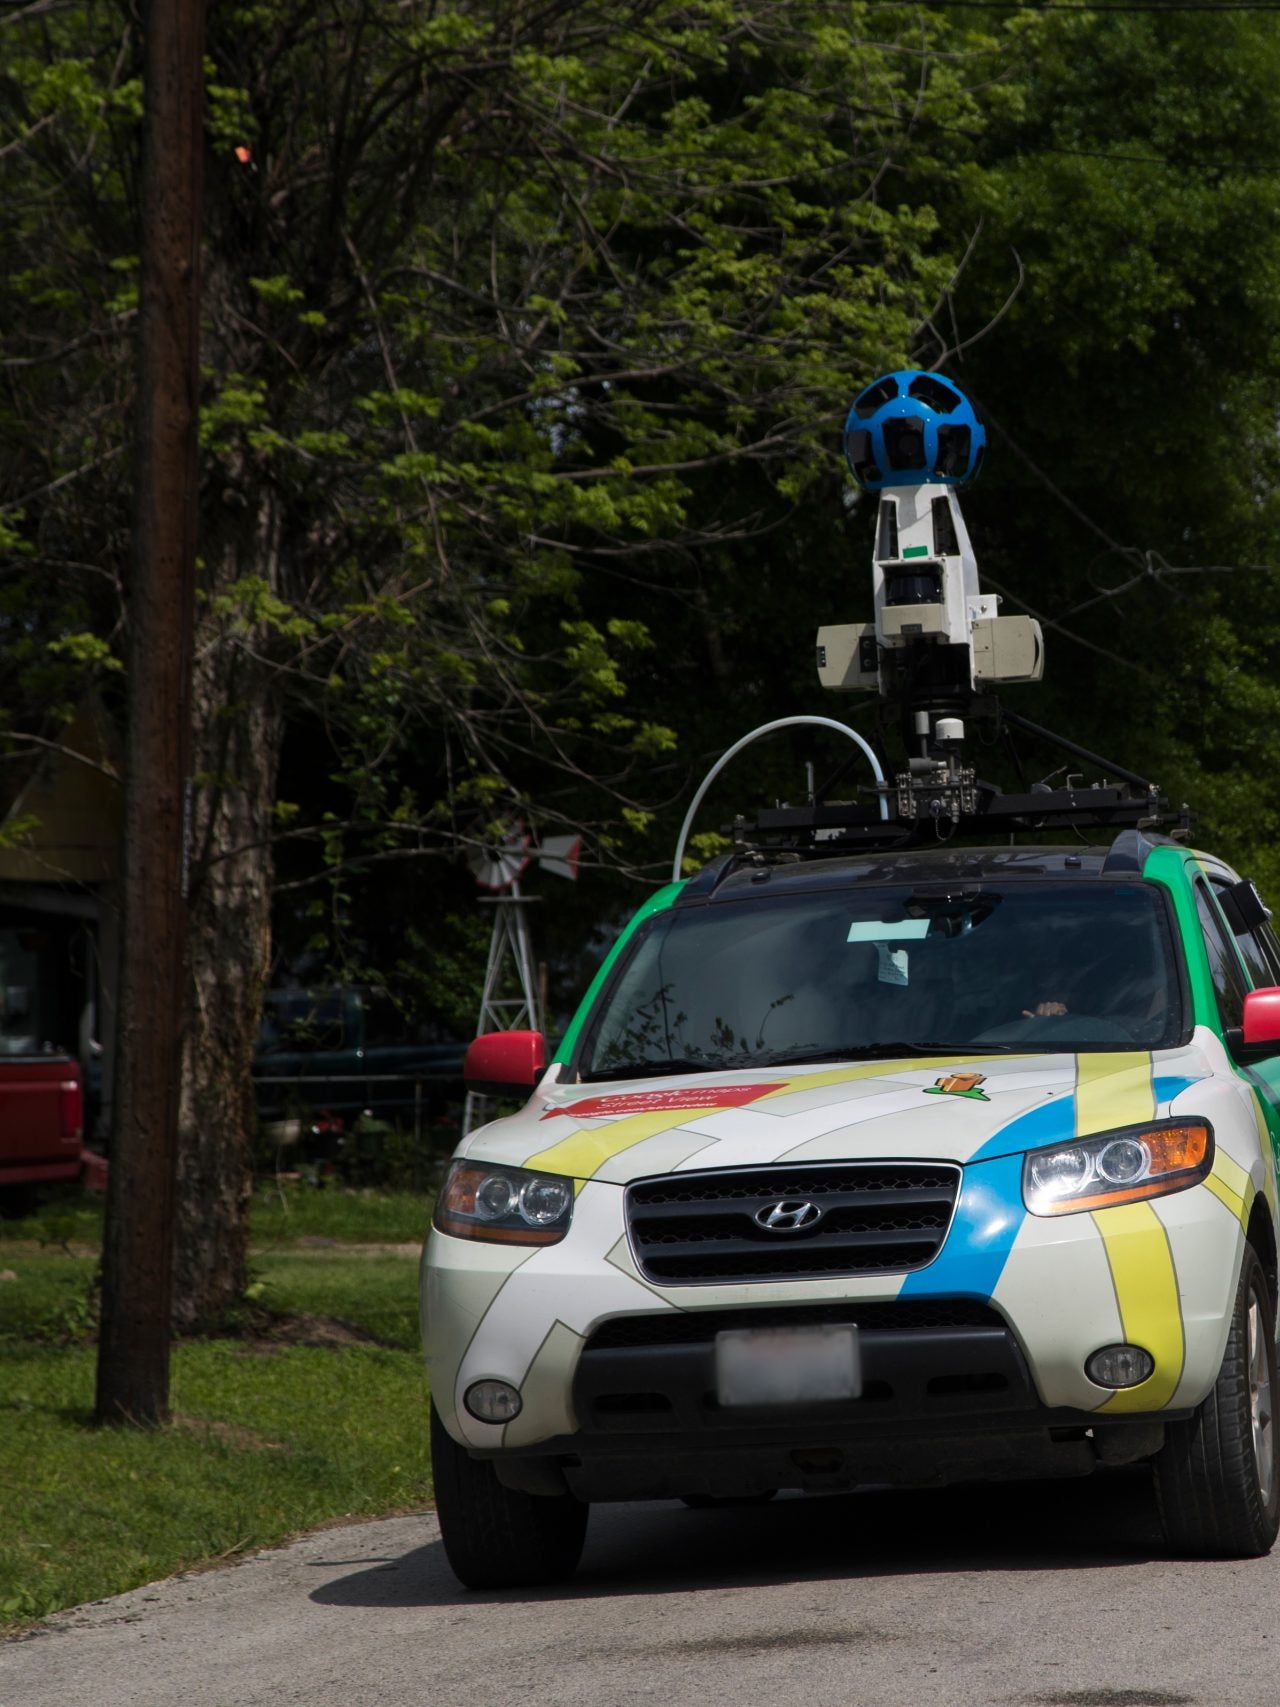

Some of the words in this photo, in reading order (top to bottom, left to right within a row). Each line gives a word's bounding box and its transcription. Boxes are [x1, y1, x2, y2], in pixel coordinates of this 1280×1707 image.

[596, 1098, 662, 1109] Street
[668, 1095, 719, 1104] View
[598, 1090, 684, 1102] Google
